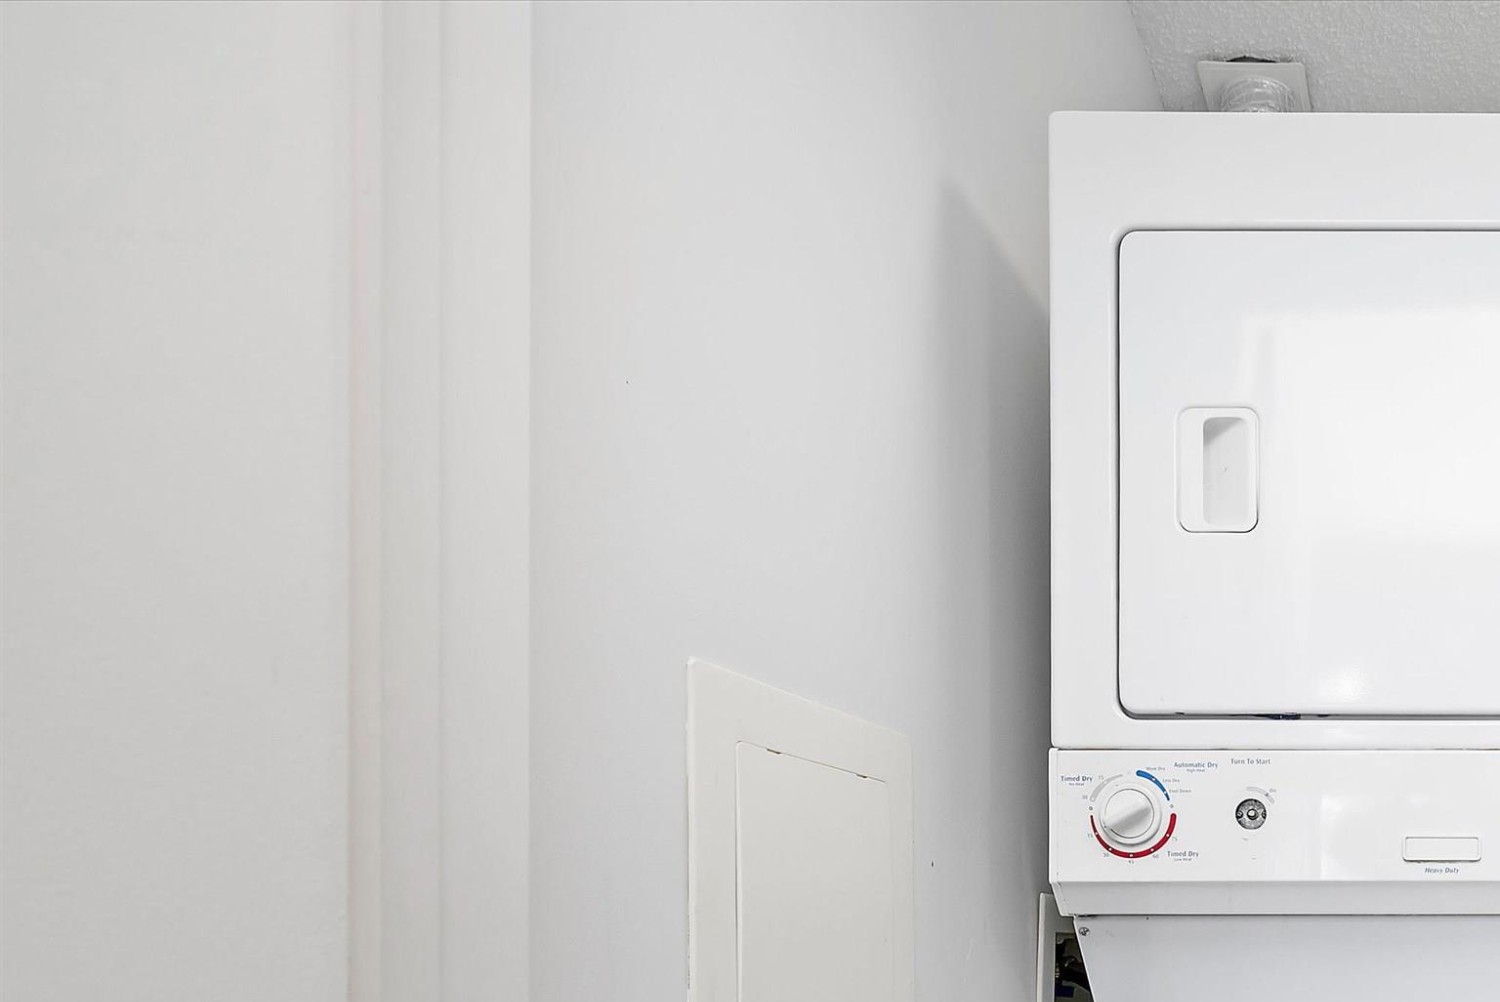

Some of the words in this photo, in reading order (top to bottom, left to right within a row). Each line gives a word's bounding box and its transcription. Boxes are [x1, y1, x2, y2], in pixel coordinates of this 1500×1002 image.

[1174, 761, 1205, 769] Automatic
[1207, 761, 1218, 770] Dry
[1082, 776, 1094, 784] Dry
[1167, 850, 1187, 858] Timed
[1188, 850, 1199, 859] Dry
[1424, 866, 1443, 874] Heavy
[1444, 866, 1460, 874] Duty
